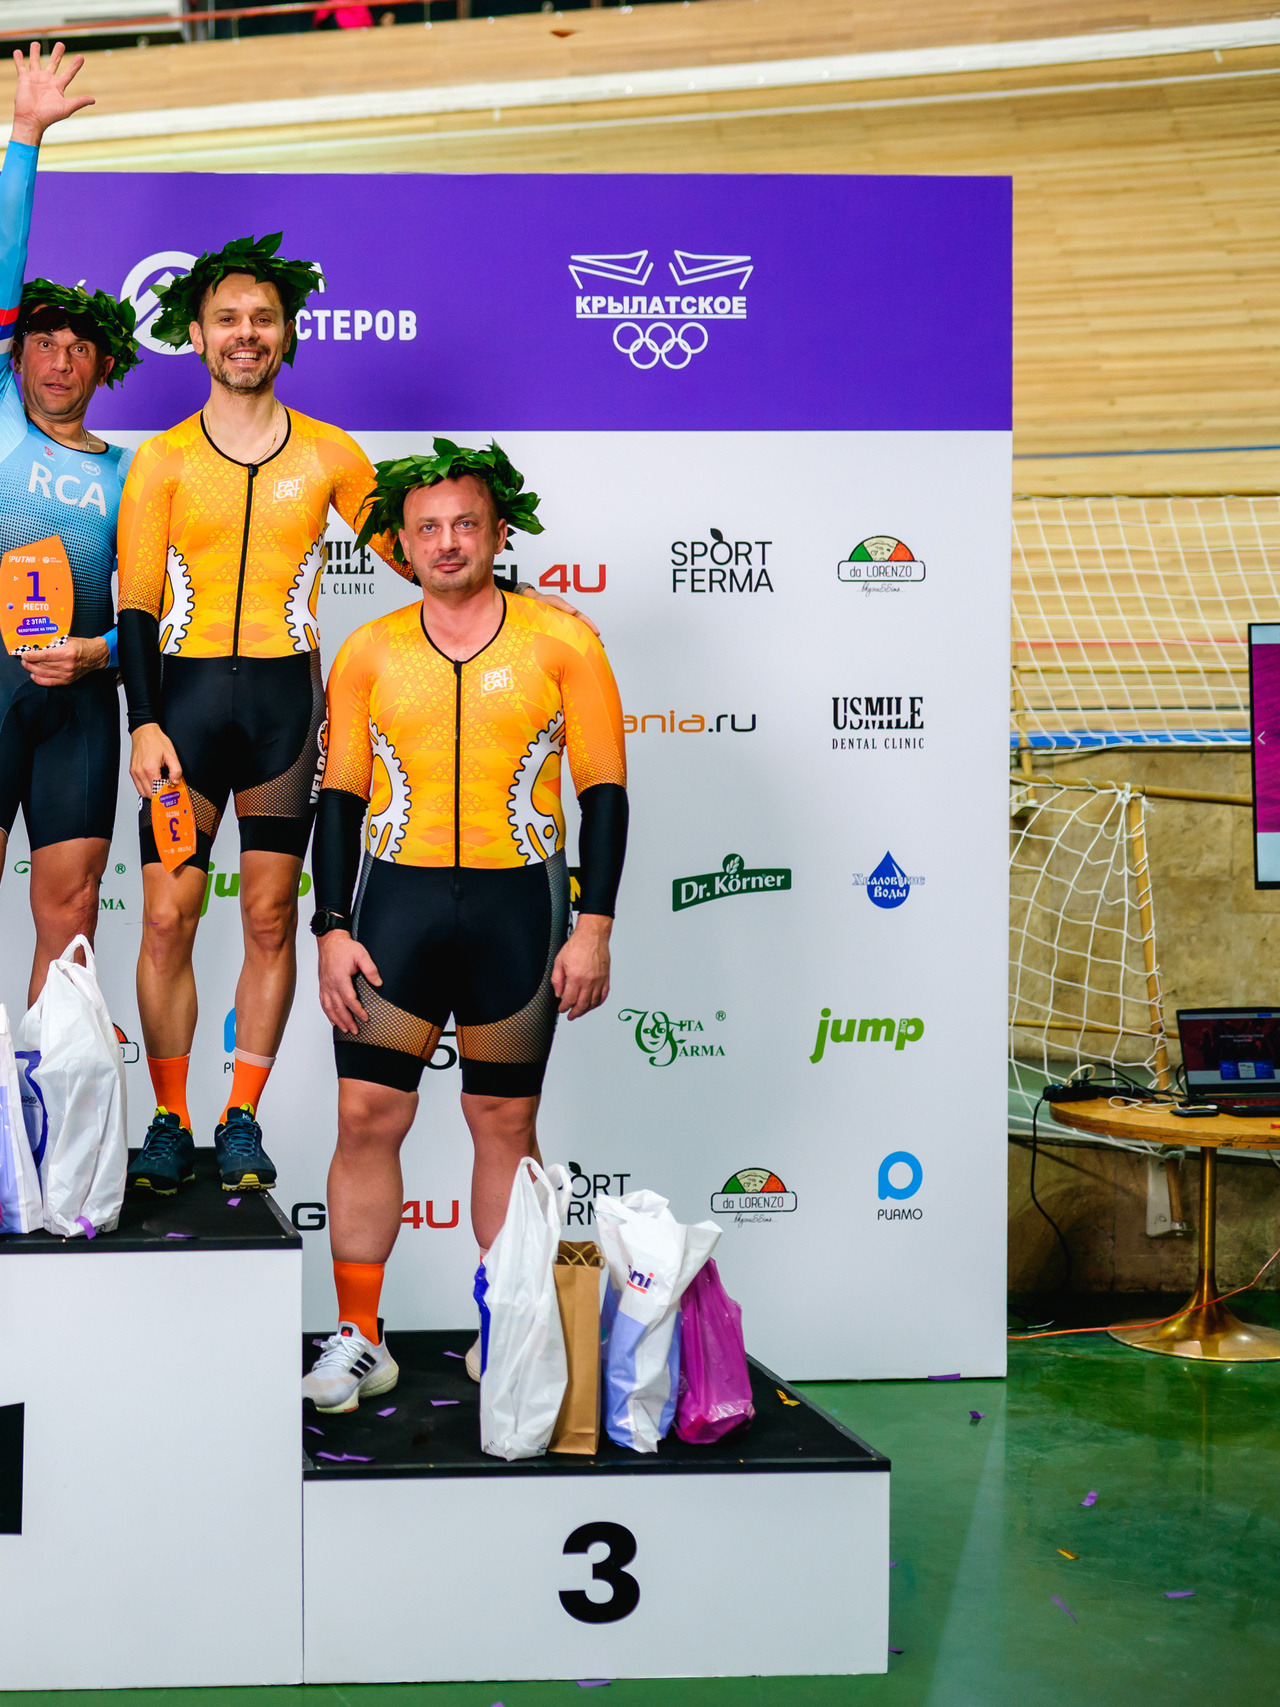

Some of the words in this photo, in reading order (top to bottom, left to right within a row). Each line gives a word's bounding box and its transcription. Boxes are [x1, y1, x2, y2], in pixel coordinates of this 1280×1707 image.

[575, 296, 746, 314] КРЫЛАТСКОЕ
[297, 309, 418, 341] СТЕРОВ
[29, 460, 107, 517] RCA
[275, 487, 300, 499] CAT
[277, 477, 301, 491] FAT
[671, 541, 773, 566] SPORT
[672, 568, 775, 592] FERMA
[849, 566, 862, 577] da
[866, 565, 912, 577] LORENZO
[26, 571, 46, 602] 1
[333, 582, 376, 596] CLINIC
[23, 603, 50, 611] МЕСТО
[485, 668, 508, 682] FAT
[484, 677, 509, 692] CAT
[831, 696, 925, 731] USMILE
[831, 737, 878, 750] DENTAL
[883, 737, 925, 750] CLINIC
[681, 879, 711, 904] Dr.
[714, 873, 785, 893] Körner
[809, 1007, 925, 1064] jump
[571, 1173, 631, 1199] ORT
[722, 1198, 735, 1209] da
[739, 1196, 785, 1208] LORENZO
[877, 1208, 924, 1221] PUAMO
[558, 1522, 640, 1625] 3
